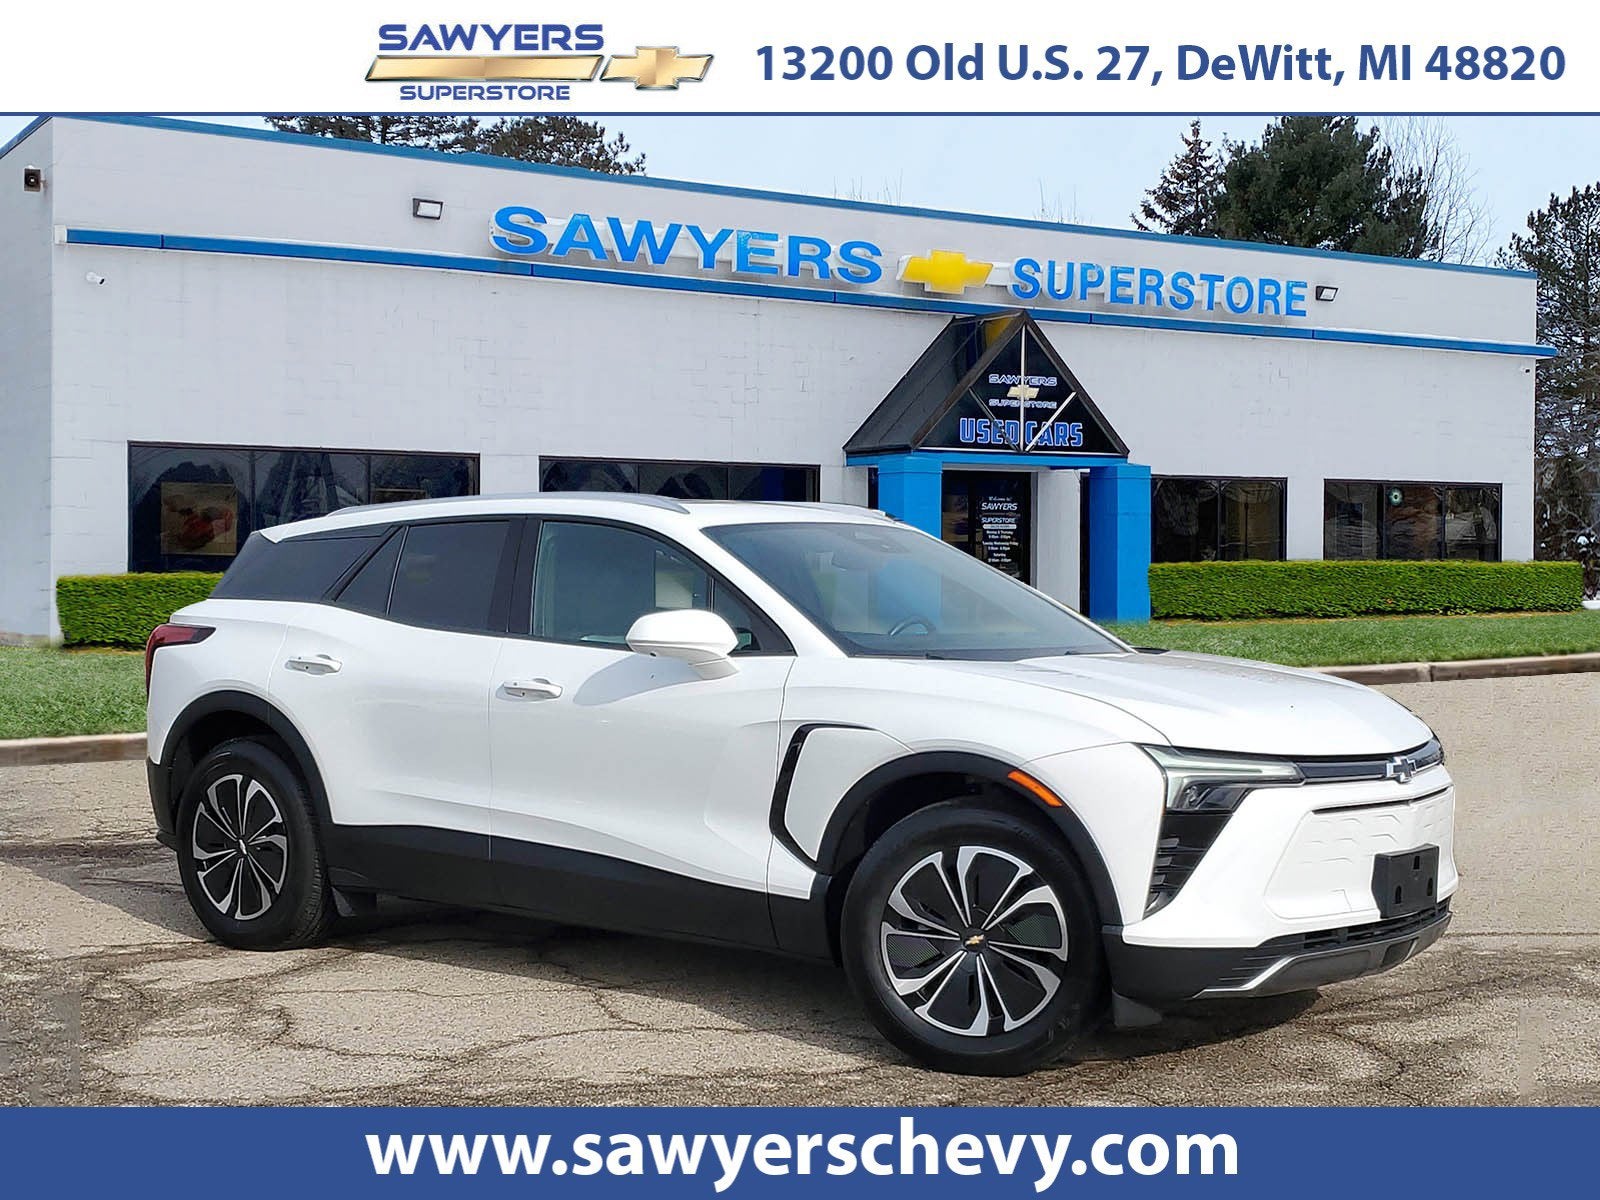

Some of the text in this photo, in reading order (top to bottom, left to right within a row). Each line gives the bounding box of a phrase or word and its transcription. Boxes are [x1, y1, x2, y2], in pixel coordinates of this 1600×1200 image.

[491, 206, 883, 285] SAWYERS
[1011, 257, 1308, 317] SUPERSTORE
[988, 374, 1057, 386] SAWYERS
[959, 417, 1084, 447] USED CARS
[981, 502, 1018, 511] SAWYERS
